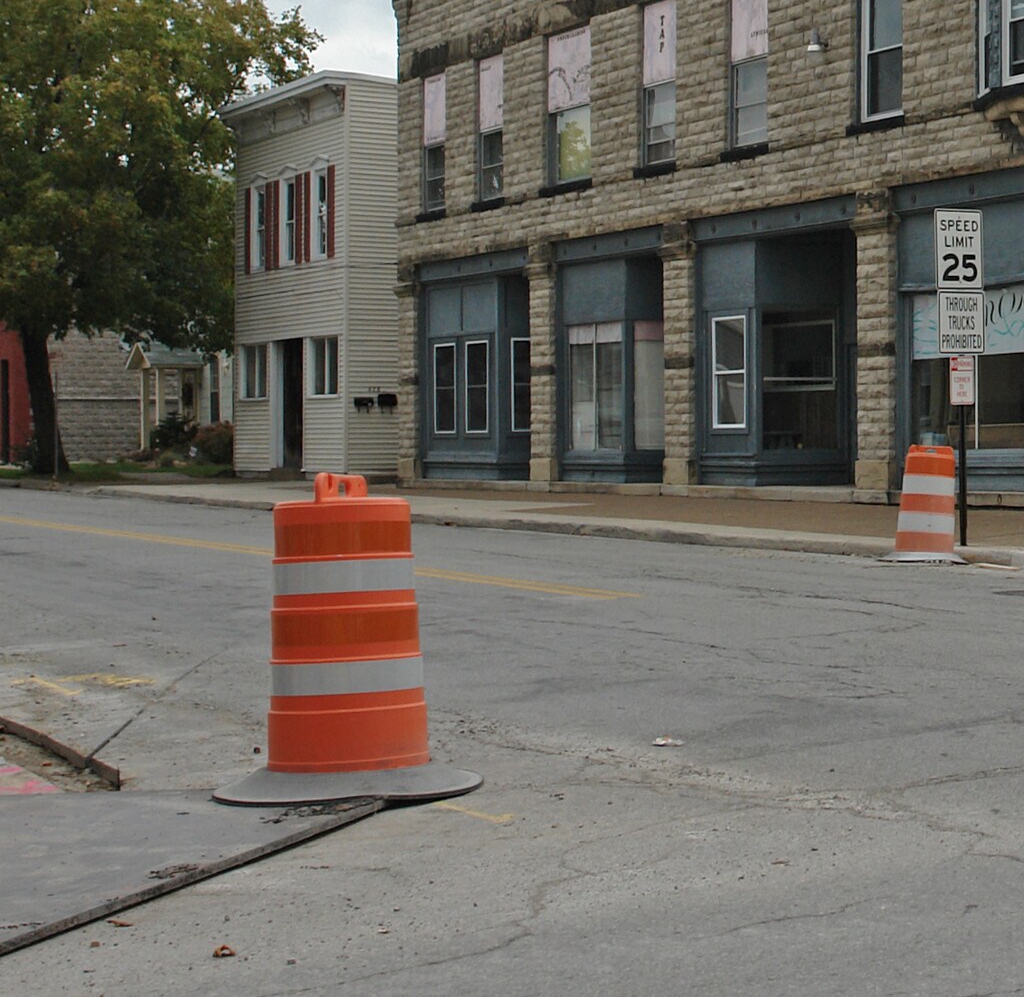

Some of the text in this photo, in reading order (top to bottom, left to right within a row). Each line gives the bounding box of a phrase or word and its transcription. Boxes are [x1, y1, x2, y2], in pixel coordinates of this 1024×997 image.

[940, 219, 979, 232] SPEED
[944, 236, 974, 248] LIMIT
[942, 253, 978, 282] 25
[945, 296, 978, 312] THROUGH
[948, 315, 976, 330] TRUCKS
[941, 334, 982, 349] PROHIBITED
